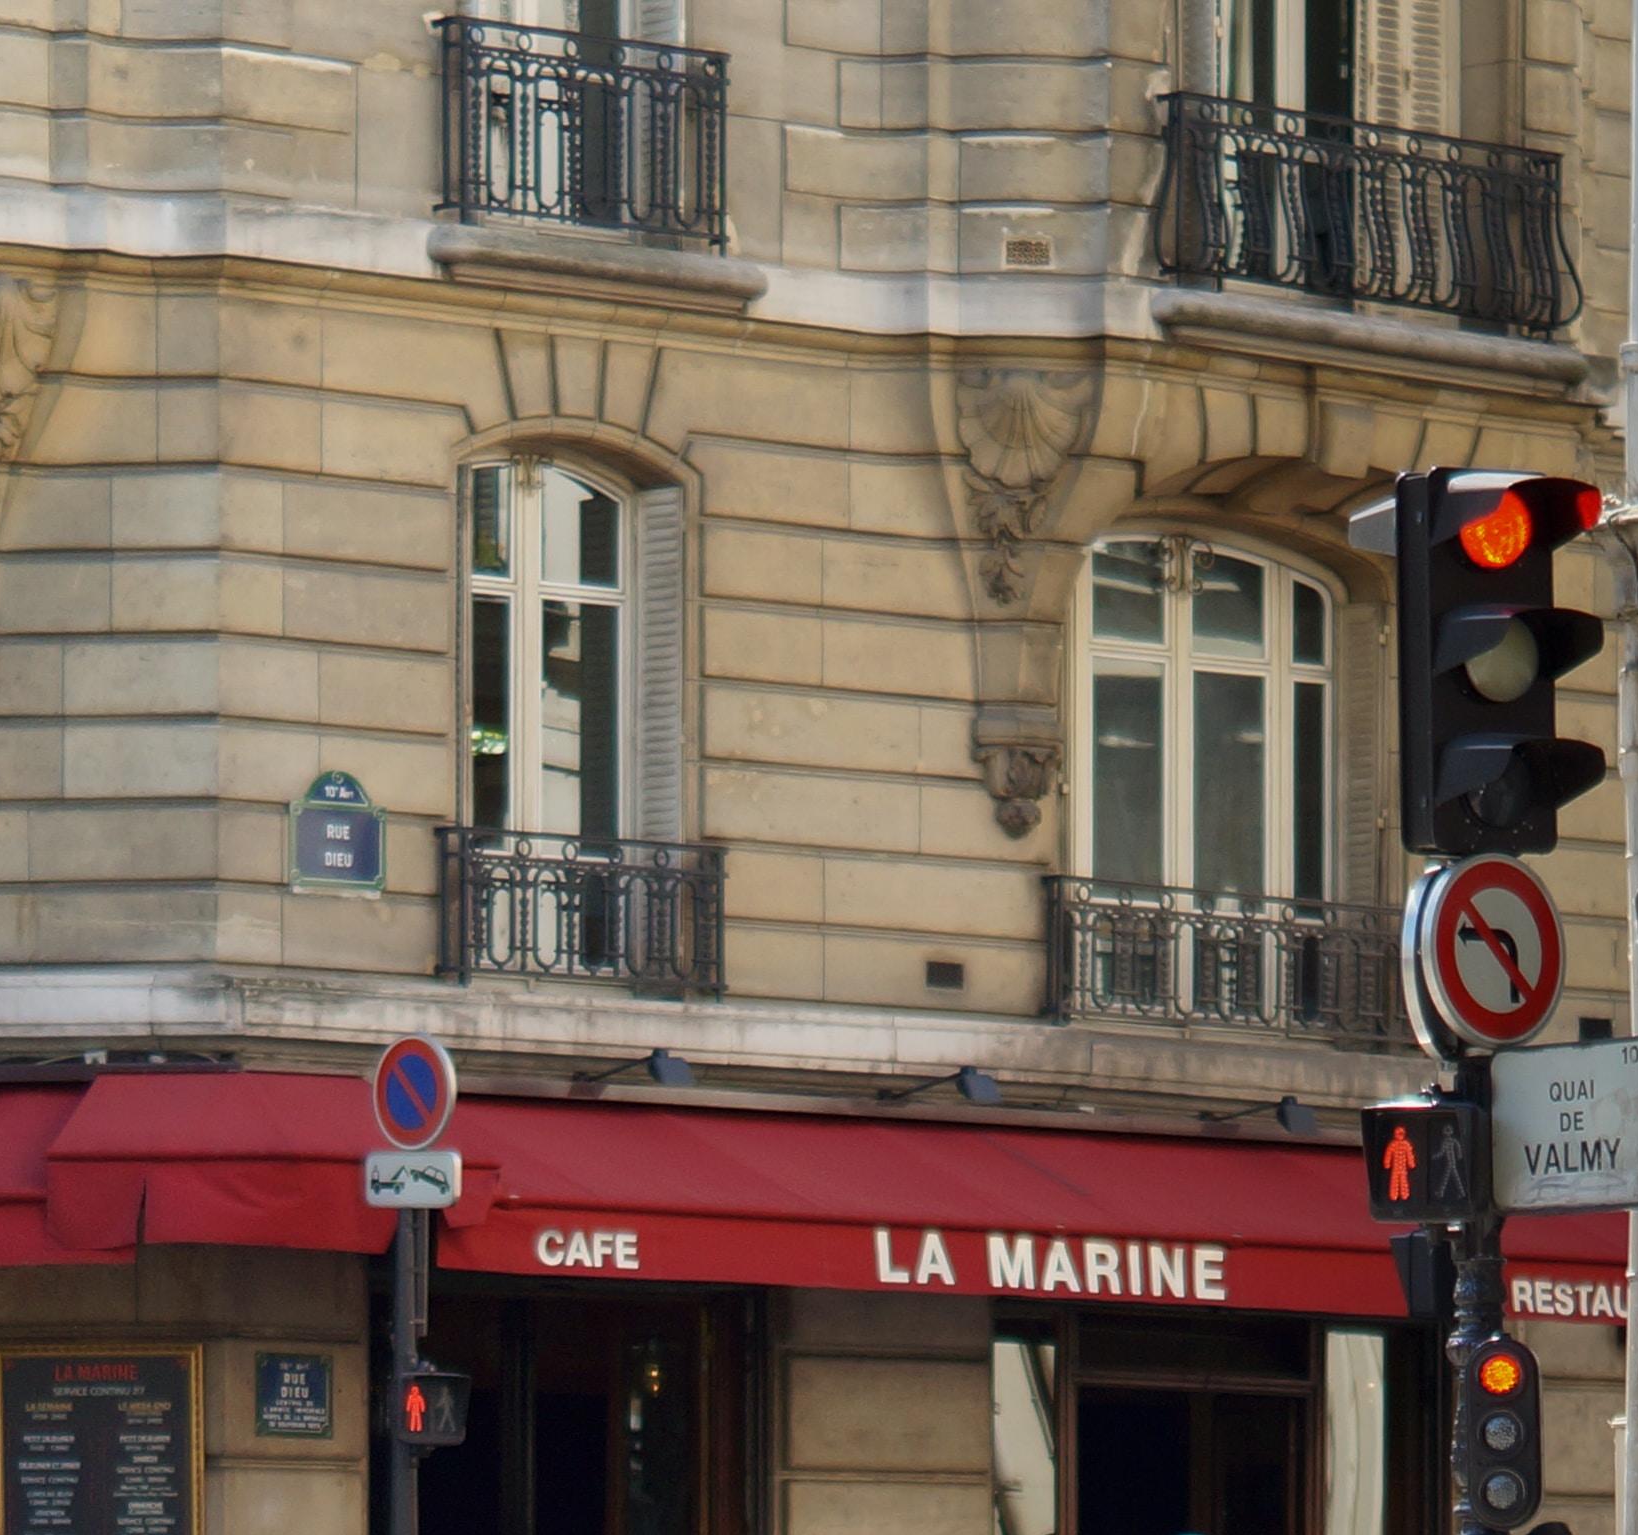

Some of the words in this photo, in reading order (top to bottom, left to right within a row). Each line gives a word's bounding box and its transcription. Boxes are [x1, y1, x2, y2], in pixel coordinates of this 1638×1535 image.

[326, 824, 351, 840] RUE
[324, 851, 354, 868] DIEU
[1549, 1079, 1595, 1103] QUAI
[1559, 1111, 1585, 1132] DE
[1524, 1138, 1621, 1176] VALMY
[537, 1229, 640, 1270] CAFE
[876, 1230, 956, 1286] LA
[988, 1235, 1227, 1301] MARINE
[54, 1364, 74, 1381] LA
[76, 1363, 140, 1381] MARINE
[283, 1373, 306, 1385] RUE
[281, 1386, 310, 1398] DIEU
